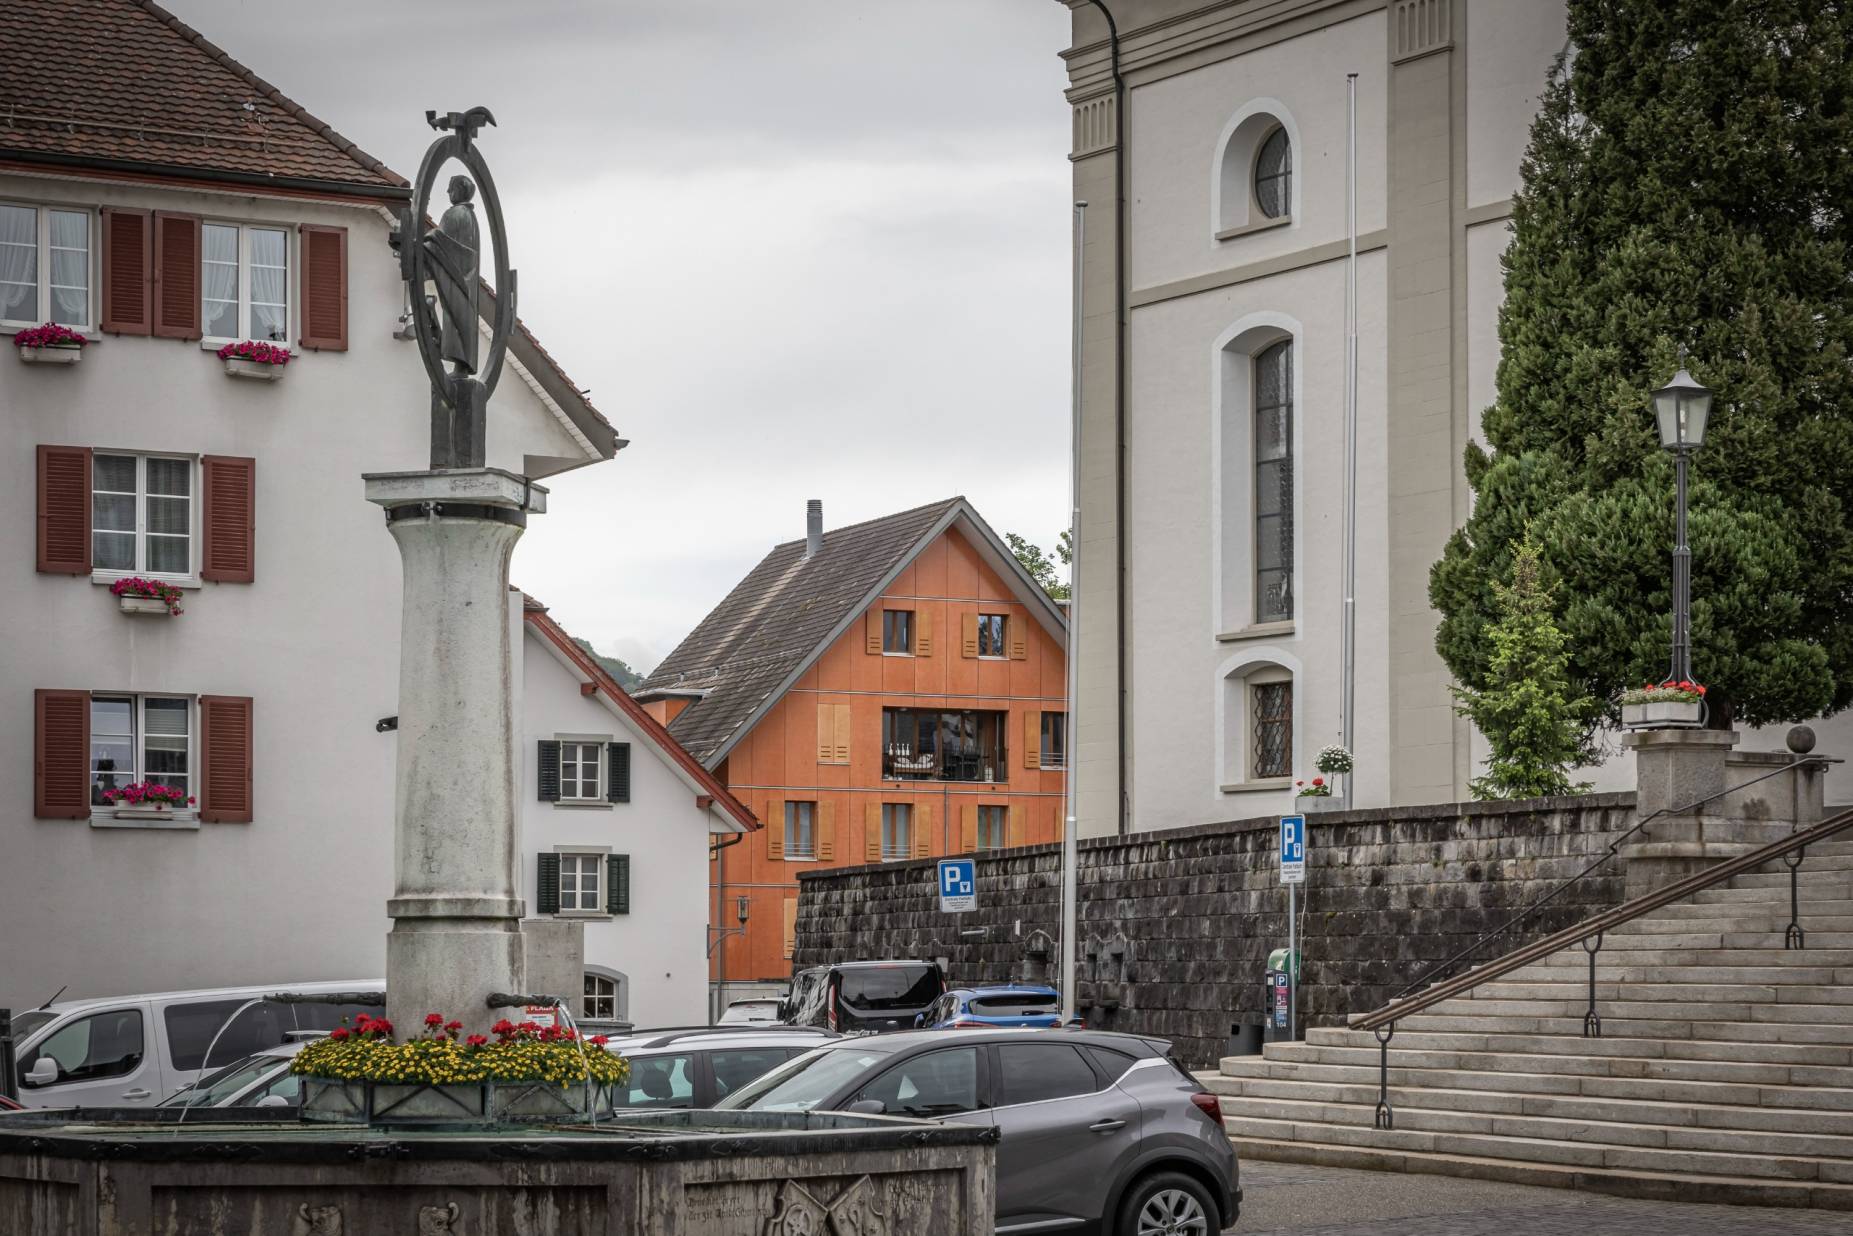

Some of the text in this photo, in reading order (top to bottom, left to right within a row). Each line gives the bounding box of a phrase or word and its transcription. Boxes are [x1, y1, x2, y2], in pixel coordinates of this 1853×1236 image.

[1284, 823, 1295, 855] P
[945, 866, 961, 892] P
[1278, 976, 1286, 986] P
